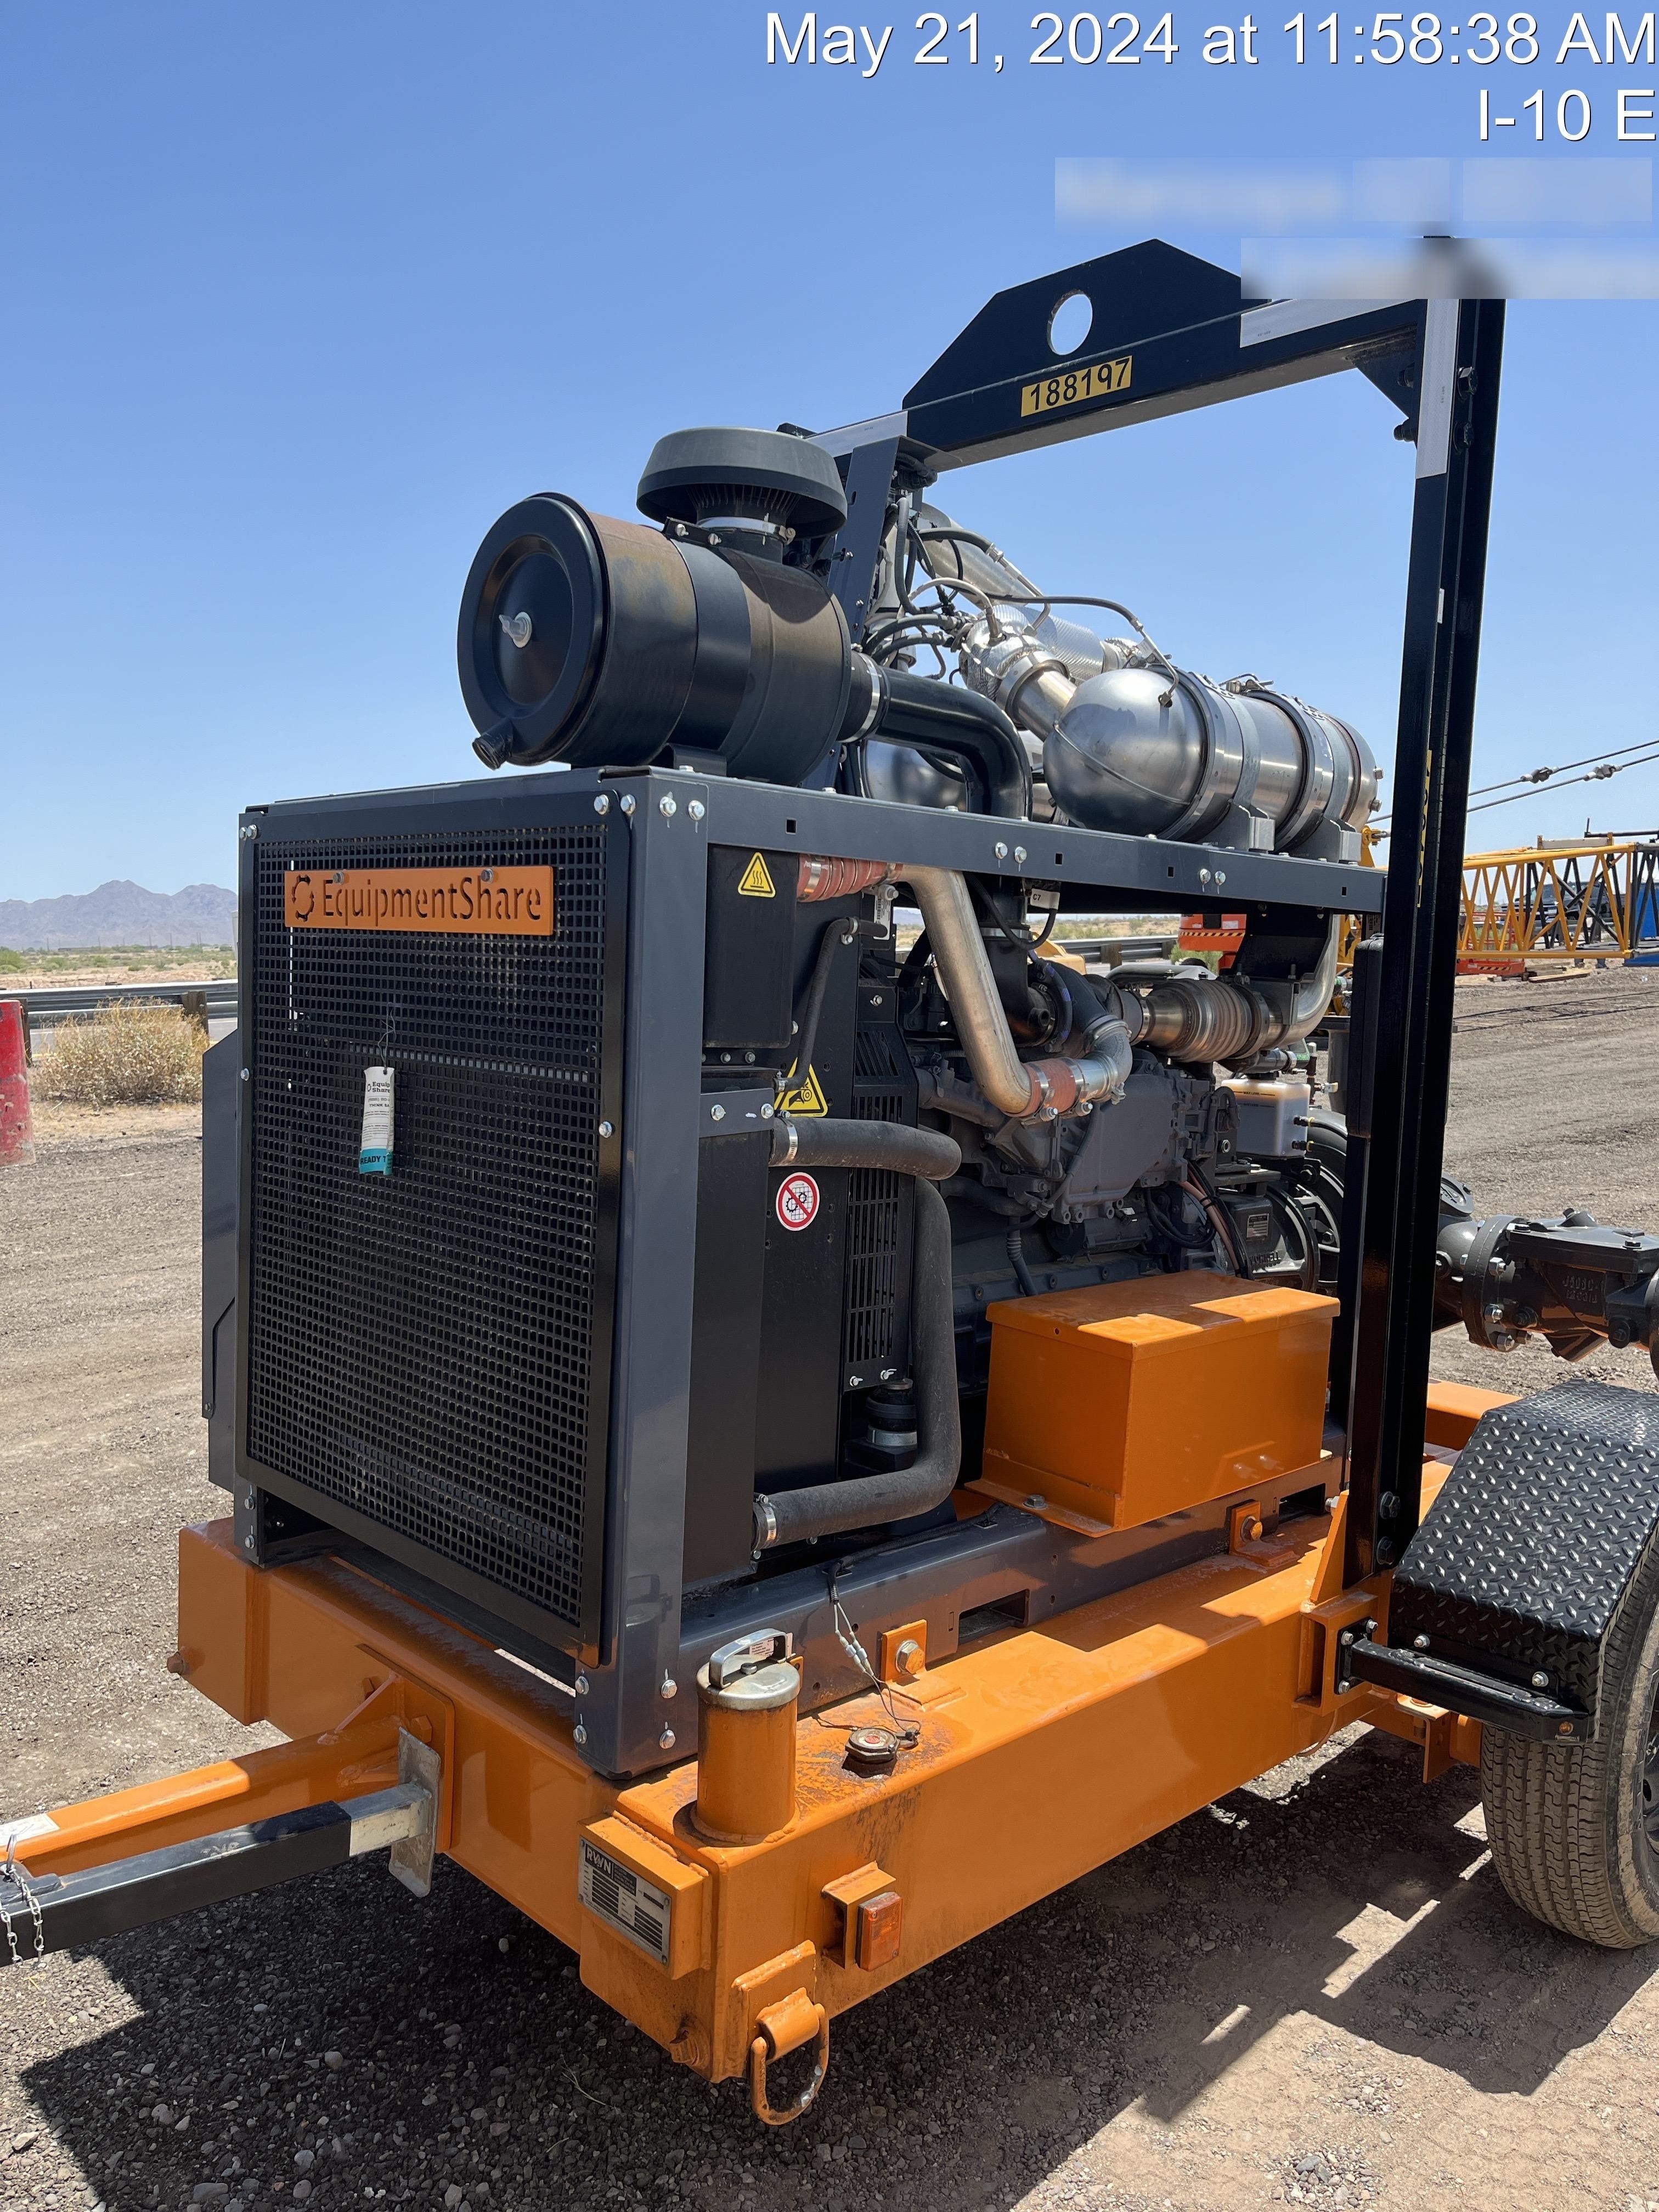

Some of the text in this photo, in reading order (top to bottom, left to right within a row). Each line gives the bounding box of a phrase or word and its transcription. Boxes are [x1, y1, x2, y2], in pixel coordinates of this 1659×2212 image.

[1030, 358, 1130, 410] 188197
[323, 876, 541, 926] EquipmentShare
[360, 1155, 382, 1166] READY
